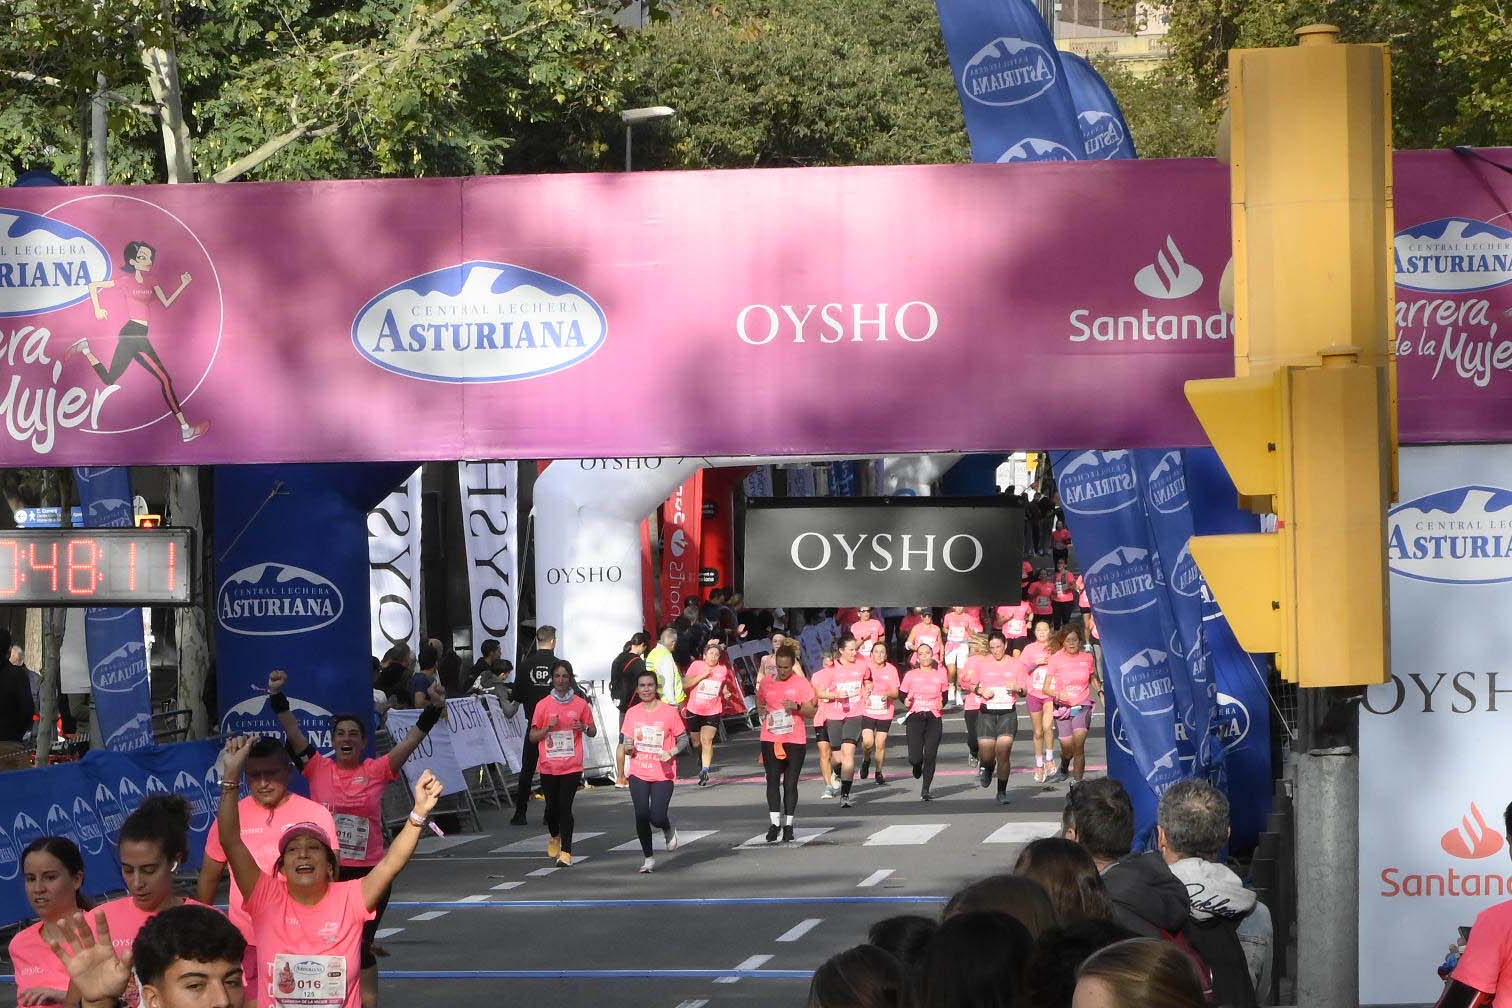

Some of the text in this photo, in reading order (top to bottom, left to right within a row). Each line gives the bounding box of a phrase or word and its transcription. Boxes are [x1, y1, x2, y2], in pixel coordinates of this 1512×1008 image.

[15, 244, 87, 256] LECHERA
[1409, 243, 1511, 251] CENTRAL LECHER
[411, 301, 579, 317] CENTRAL LECHERA
[1396, 298, 1490, 326] arrera
[372, 308, 587, 352] ASTURIANA
[736, 301, 939, 345] OYSHO
[1418, 331, 1436, 356] la
[1432, 323, 1512, 387] Muje
[1416, 521, 1483, 531] CENTRAL
[790, 532, 984, 573] OYSHO
[547, 566, 622, 585] OYSHO
[234, 586, 329, 596] CENTRAL LECHERA
[222, 592, 334, 620] ASTURIANA
[235, 720, 277, 728] CENTRAL
[297, 980, 321, 989] 016
